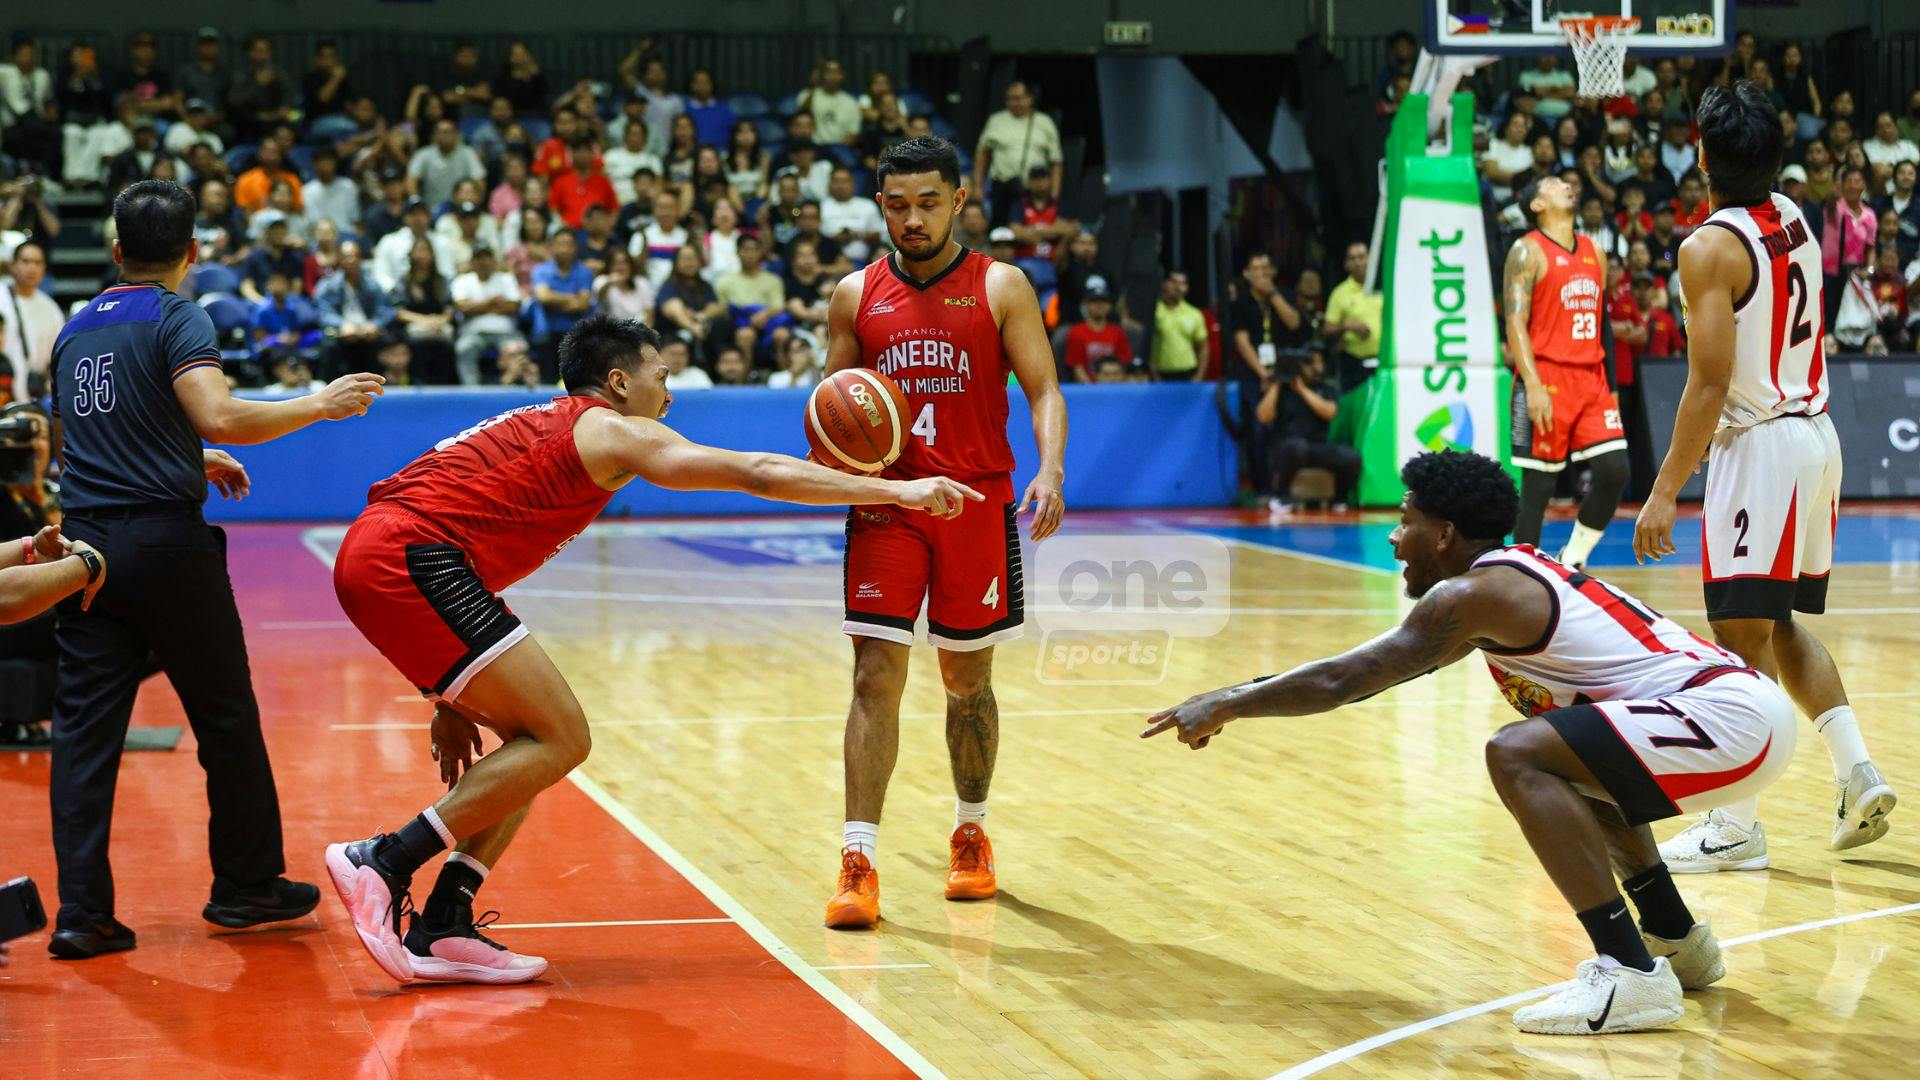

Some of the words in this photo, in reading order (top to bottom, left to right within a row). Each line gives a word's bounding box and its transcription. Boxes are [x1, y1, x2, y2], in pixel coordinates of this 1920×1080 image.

[1418, 228, 1468, 393] Smart
[1571, 312, 1597, 340] 23
[1787, 261, 1812, 349] 2
[889, 328, 952, 342] BARANGAY
[877, 340, 971, 381] GINEBRA
[74, 352, 116, 417] 35
[916, 376, 966, 394] MIGUEL
[825, 400, 855, 444] molten
[910, 402, 937, 446] 4
[1733, 508, 1749, 558] 2
[981, 576, 999, 610] 4
[1625, 699, 1717, 750] 77
